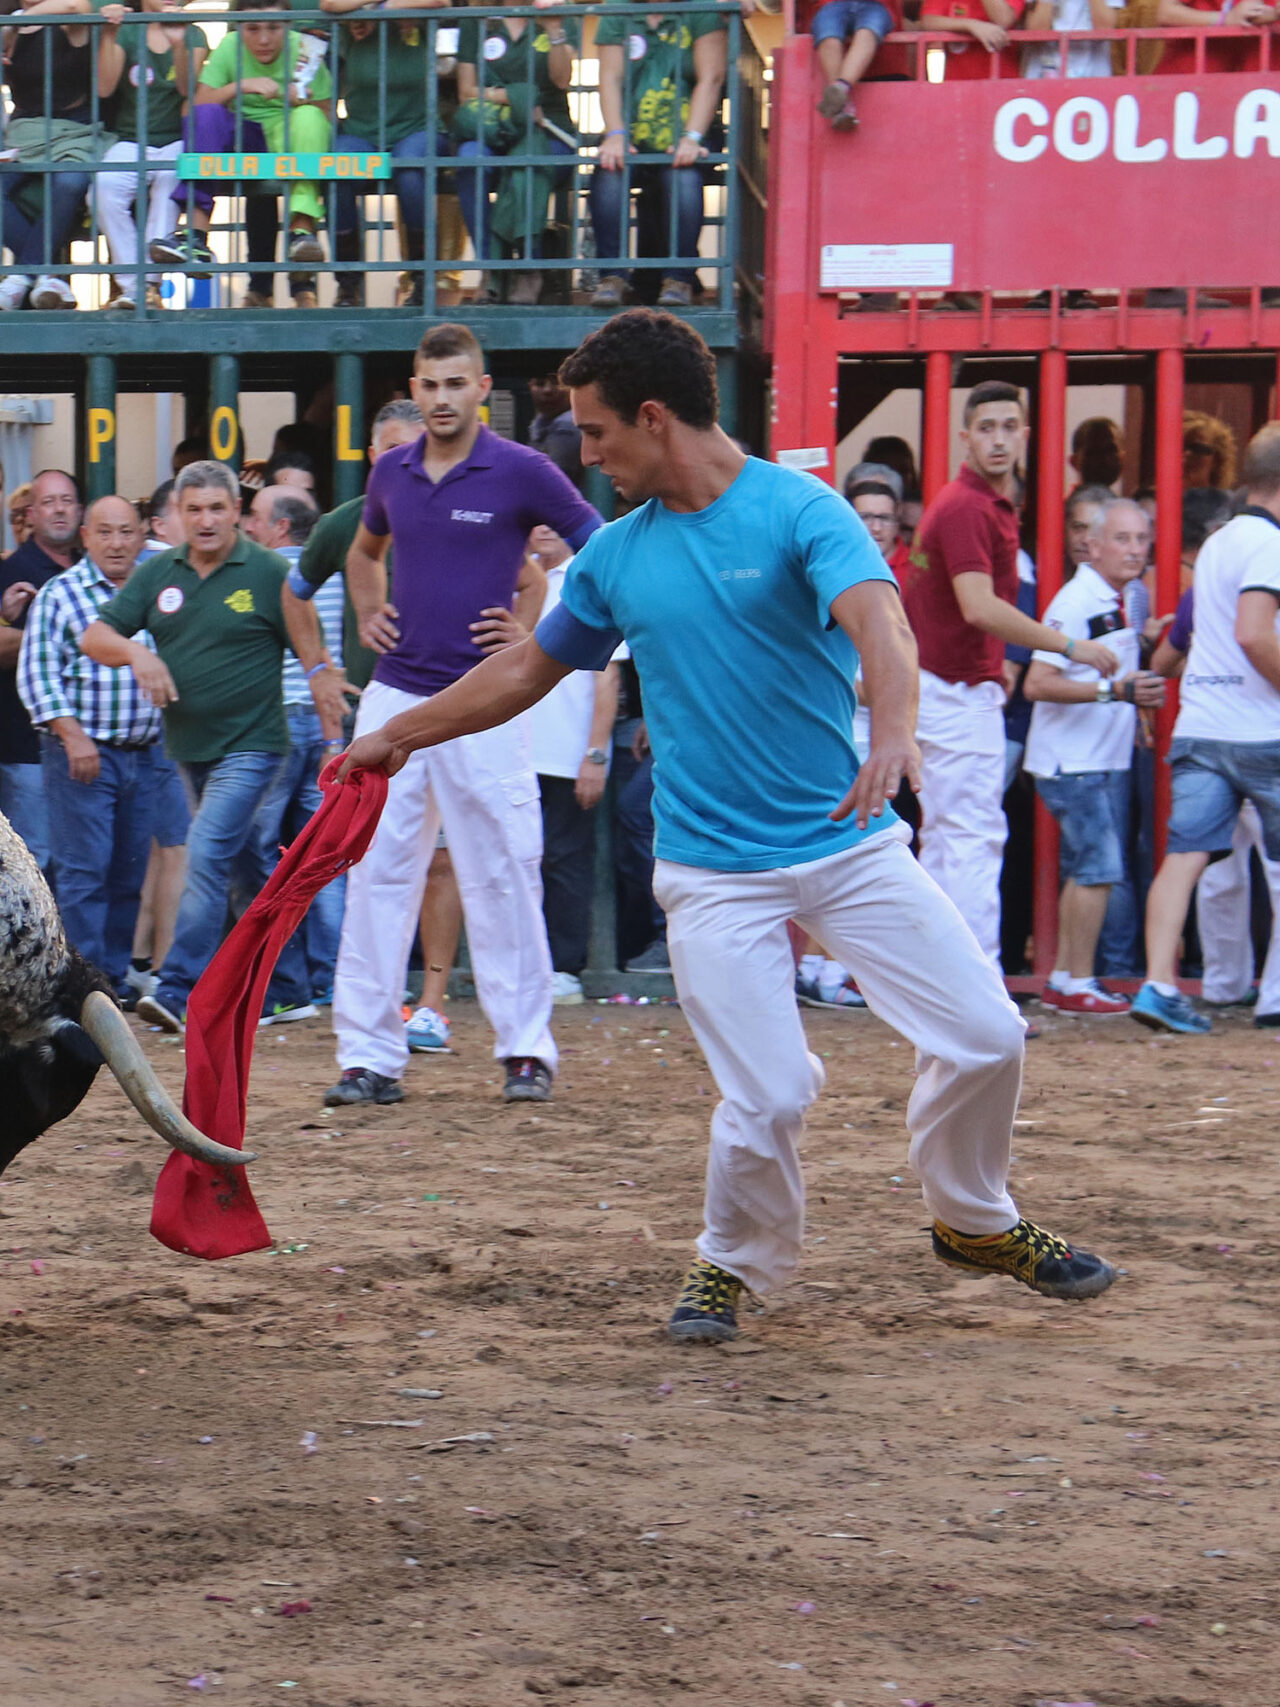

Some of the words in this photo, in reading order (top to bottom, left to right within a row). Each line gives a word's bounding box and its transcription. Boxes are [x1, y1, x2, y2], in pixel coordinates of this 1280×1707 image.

[993, 88, 1280, 163] COLLA
[274, 156, 306, 177] EL
[318, 156, 383, 179] POLP
